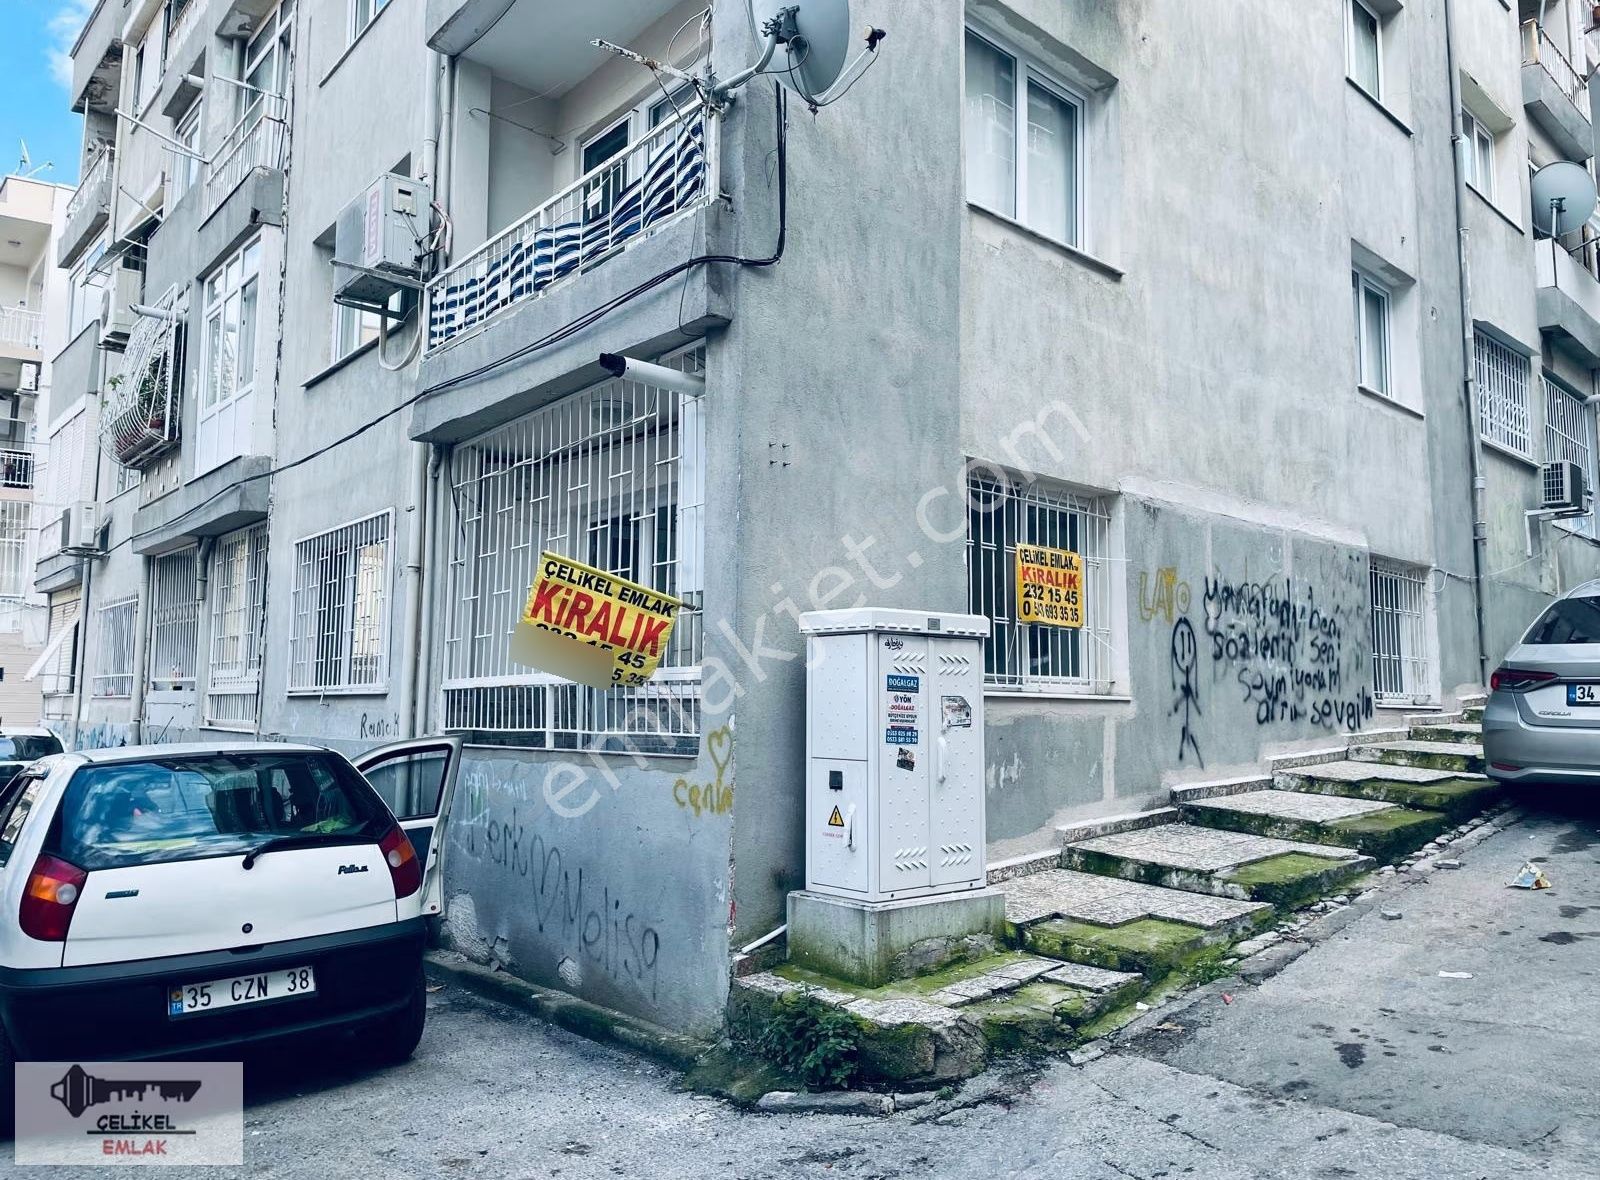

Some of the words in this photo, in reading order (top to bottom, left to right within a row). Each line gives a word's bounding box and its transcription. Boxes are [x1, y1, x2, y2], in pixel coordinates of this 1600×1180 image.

[1050, 552, 1075, 571] EMLAK
[617, 587, 676, 617] EMLAK
[1023, 583, 1045, 600] 232
[1048, 587, 1062, 603] 15
[1064, 590, 1078, 605] 45
[1022, 600, 1031, 616] 0
[1045, 603, 1058, 620] 693
[1059, 605, 1069, 621] 35
[1069, 607, 1079, 622] 35
[617, 651, 647, 669] 45
[899, 694, 911, 703] YÖN
[1577, 686, 1595, 700] 34
[172, 1002, 182, 1010] TR
[187, 985, 212, 1009] 35
[231, 975, 268, 1002] CZN
[287, 969, 309, 993] 38
